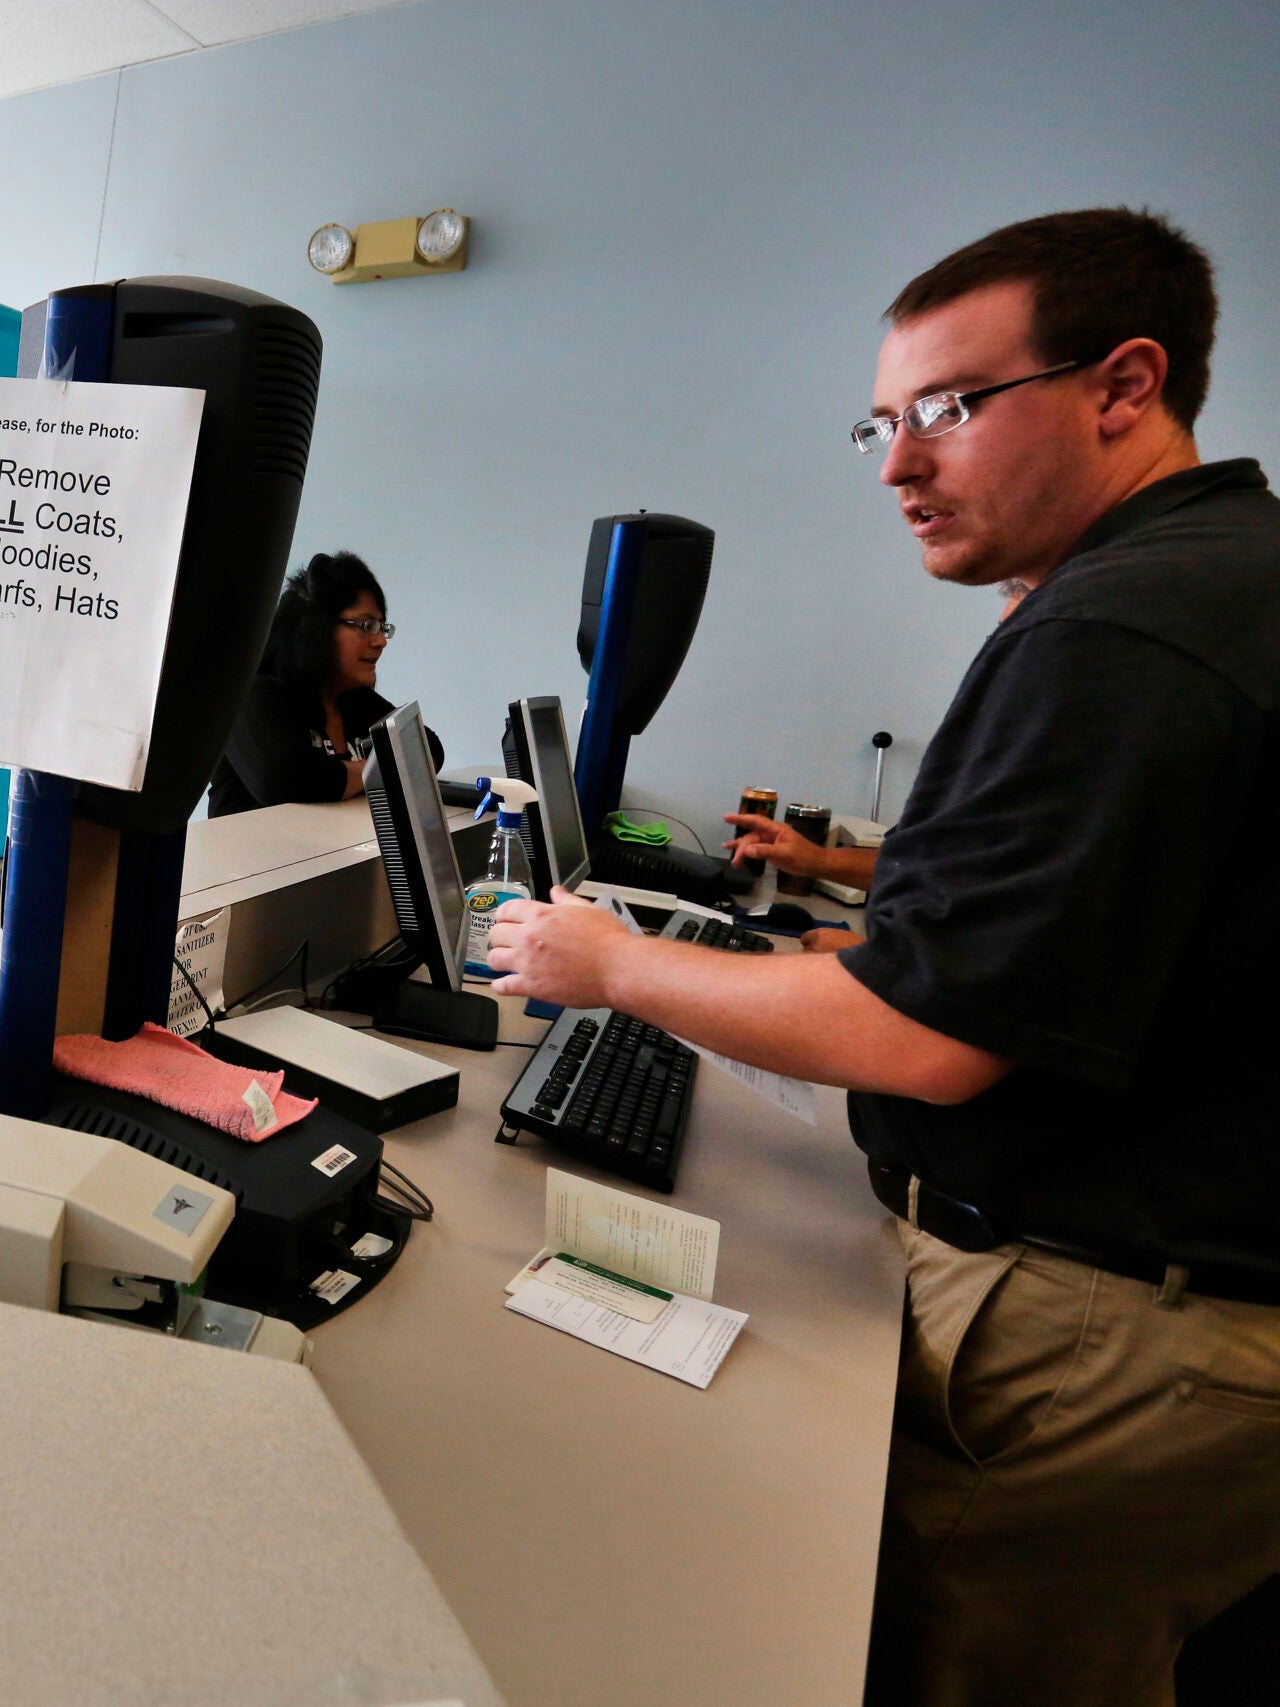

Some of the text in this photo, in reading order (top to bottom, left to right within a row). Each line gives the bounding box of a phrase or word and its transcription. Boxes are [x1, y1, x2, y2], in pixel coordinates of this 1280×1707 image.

[36, 418, 56, 433] for
[60, 421, 84, 436] the
[88, 422, 139, 440] Photo:
[35, 502, 124, 544] Coats,
[54, 584, 120, 620] Hats
[176, 932, 215, 957] SANITIZER
